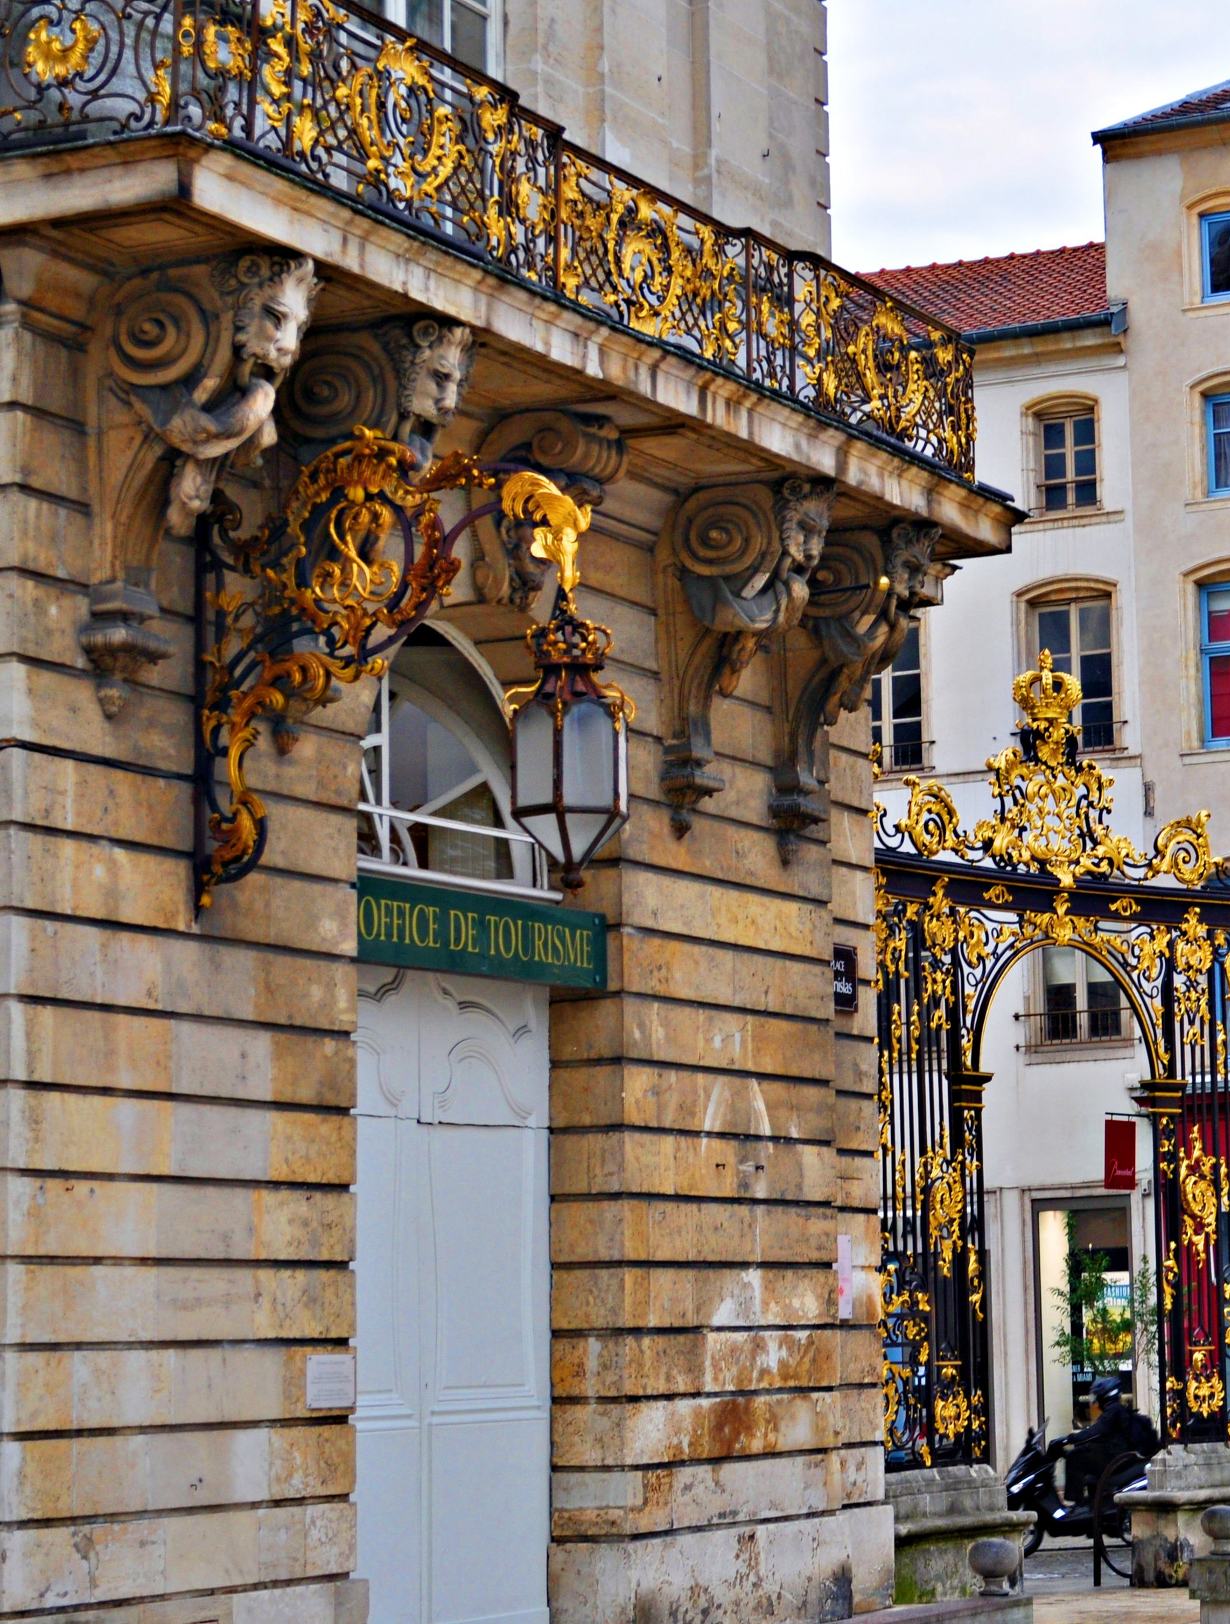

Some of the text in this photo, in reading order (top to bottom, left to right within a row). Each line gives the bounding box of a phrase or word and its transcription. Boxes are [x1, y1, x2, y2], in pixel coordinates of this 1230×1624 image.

[359, 896, 593, 968] OFFICE DE TOURISME
